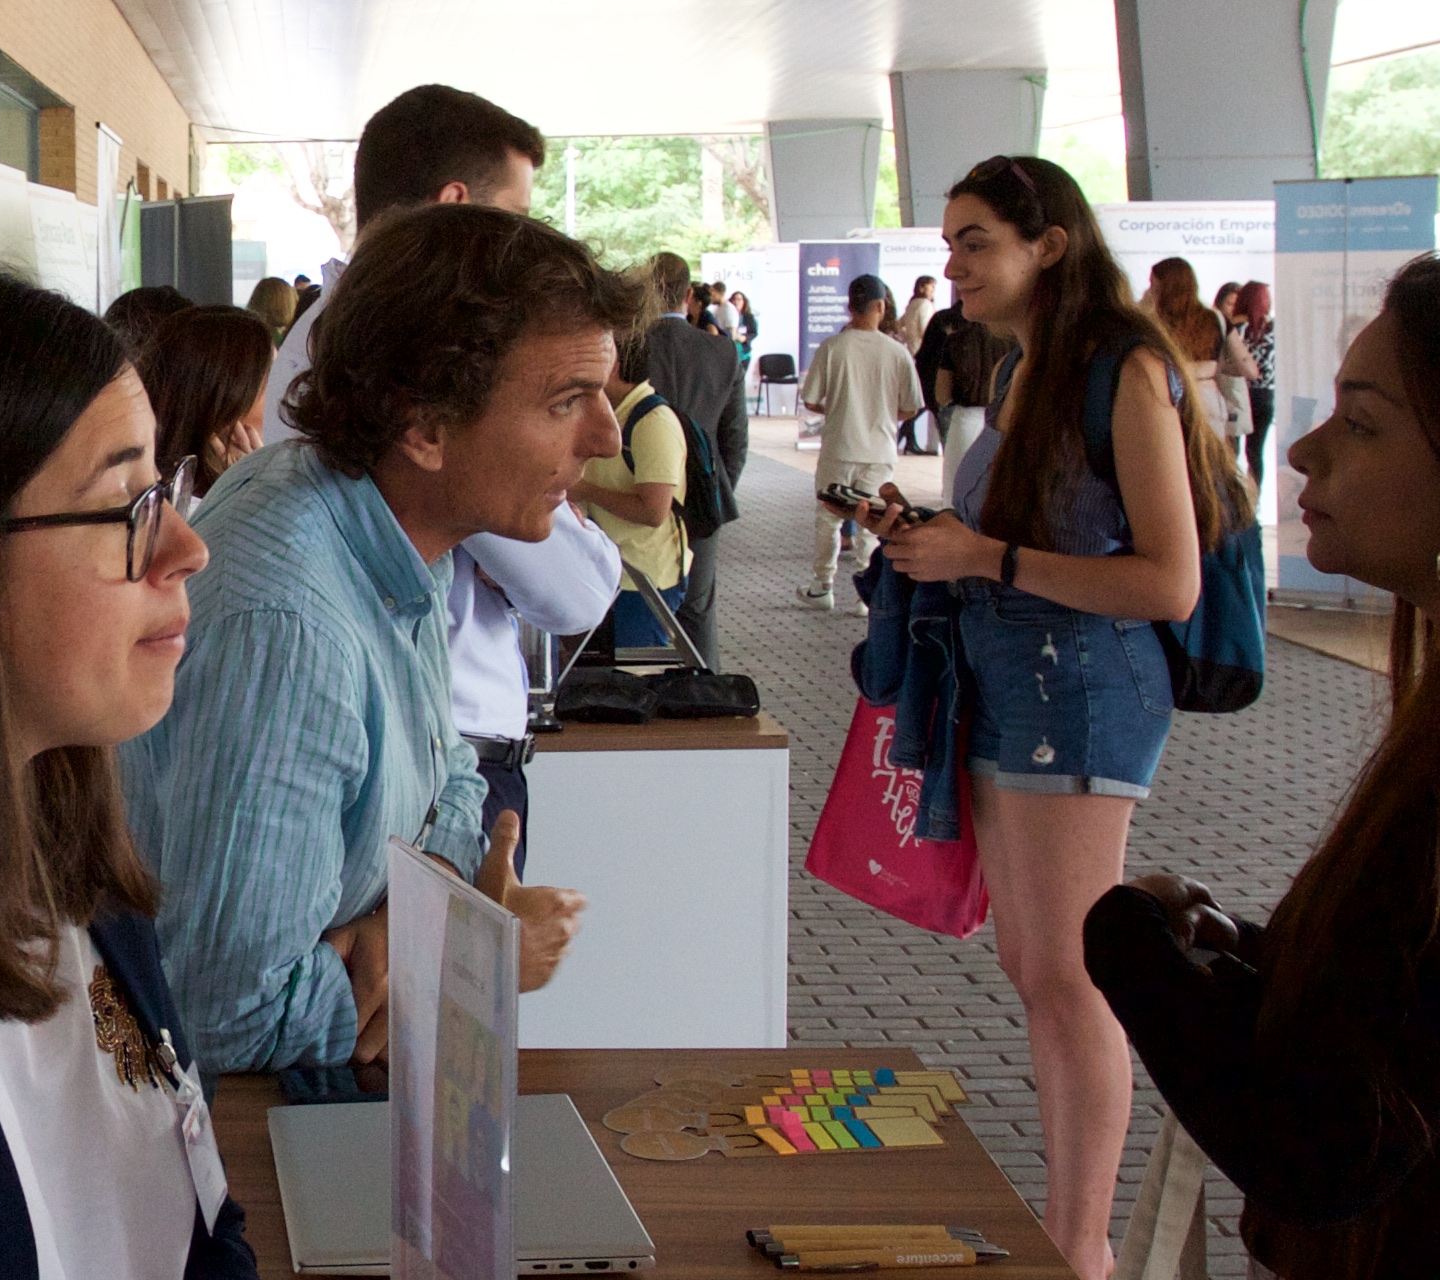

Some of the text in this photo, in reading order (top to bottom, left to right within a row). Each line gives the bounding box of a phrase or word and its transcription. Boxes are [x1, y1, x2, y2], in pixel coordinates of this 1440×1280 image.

[1119, 218, 1215, 233] Corporación
[1182, 232, 1244, 246] Vectalia
[807, 262, 840, 276] chm
[897, 1253, 964, 1265] accenture
